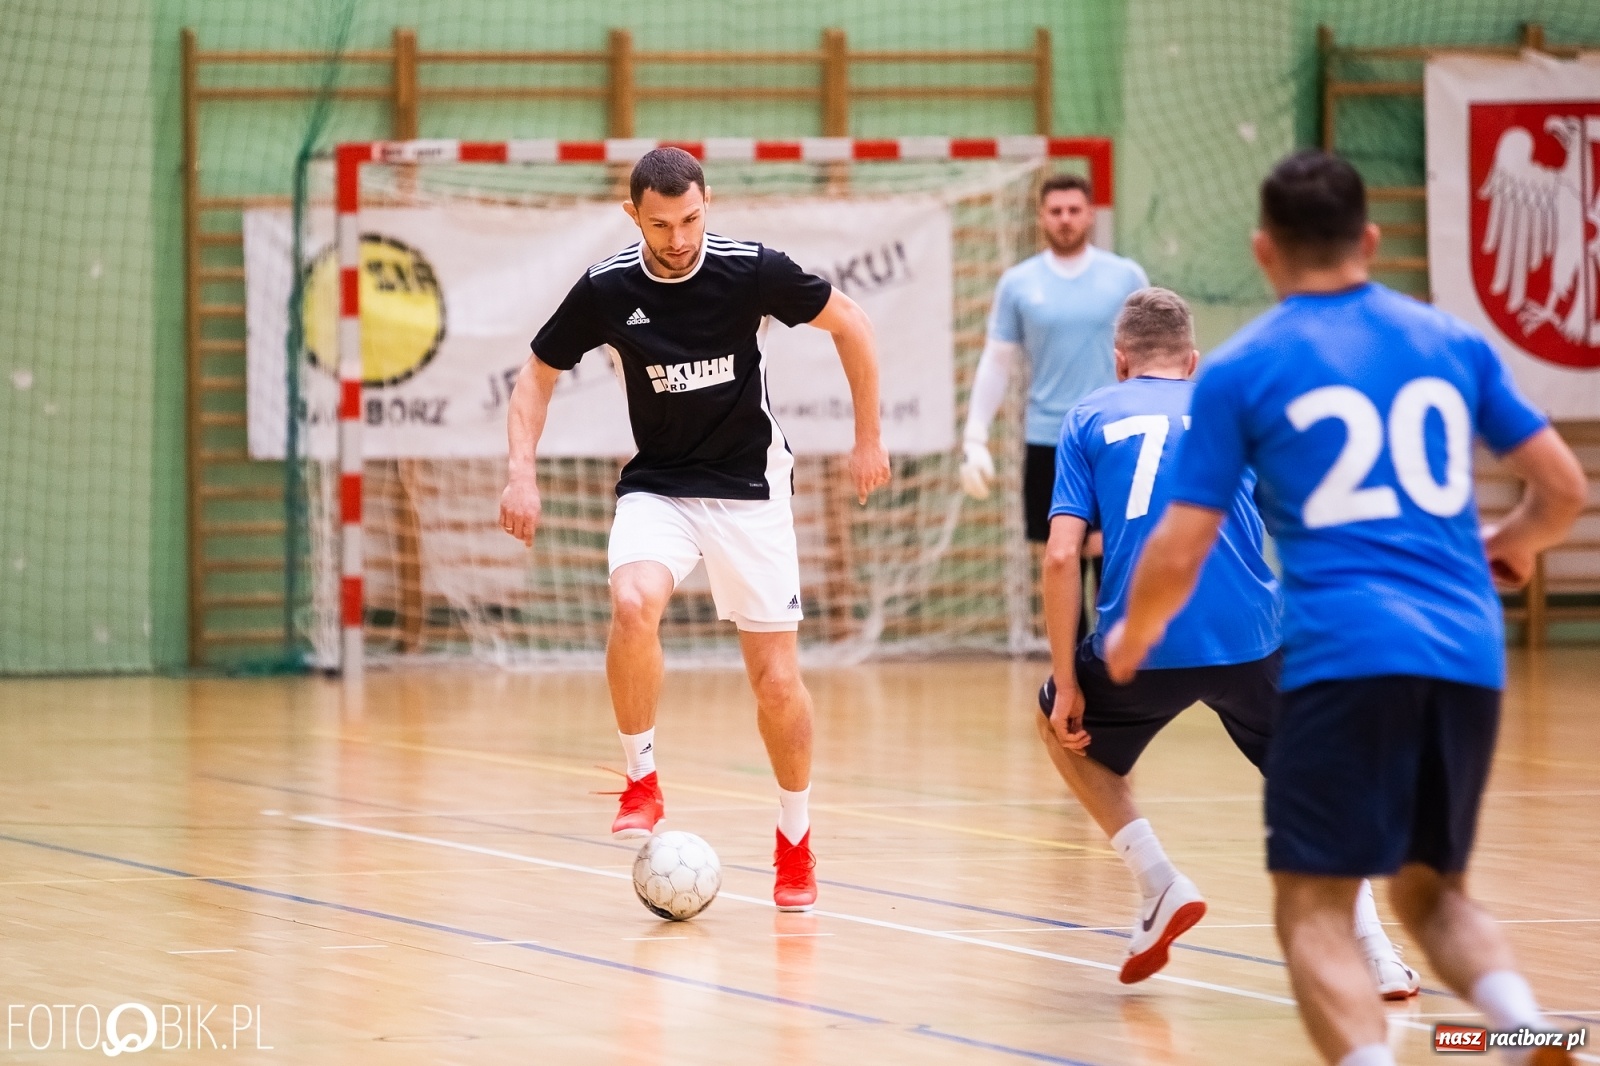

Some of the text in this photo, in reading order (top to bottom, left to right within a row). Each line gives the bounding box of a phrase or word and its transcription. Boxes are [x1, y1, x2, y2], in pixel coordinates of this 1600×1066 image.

[626, 317, 650, 326] adidas
[666, 354, 735, 383] KUHN
[1103, 414, 1192, 520] 7
[1285, 376, 1472, 530] 20
